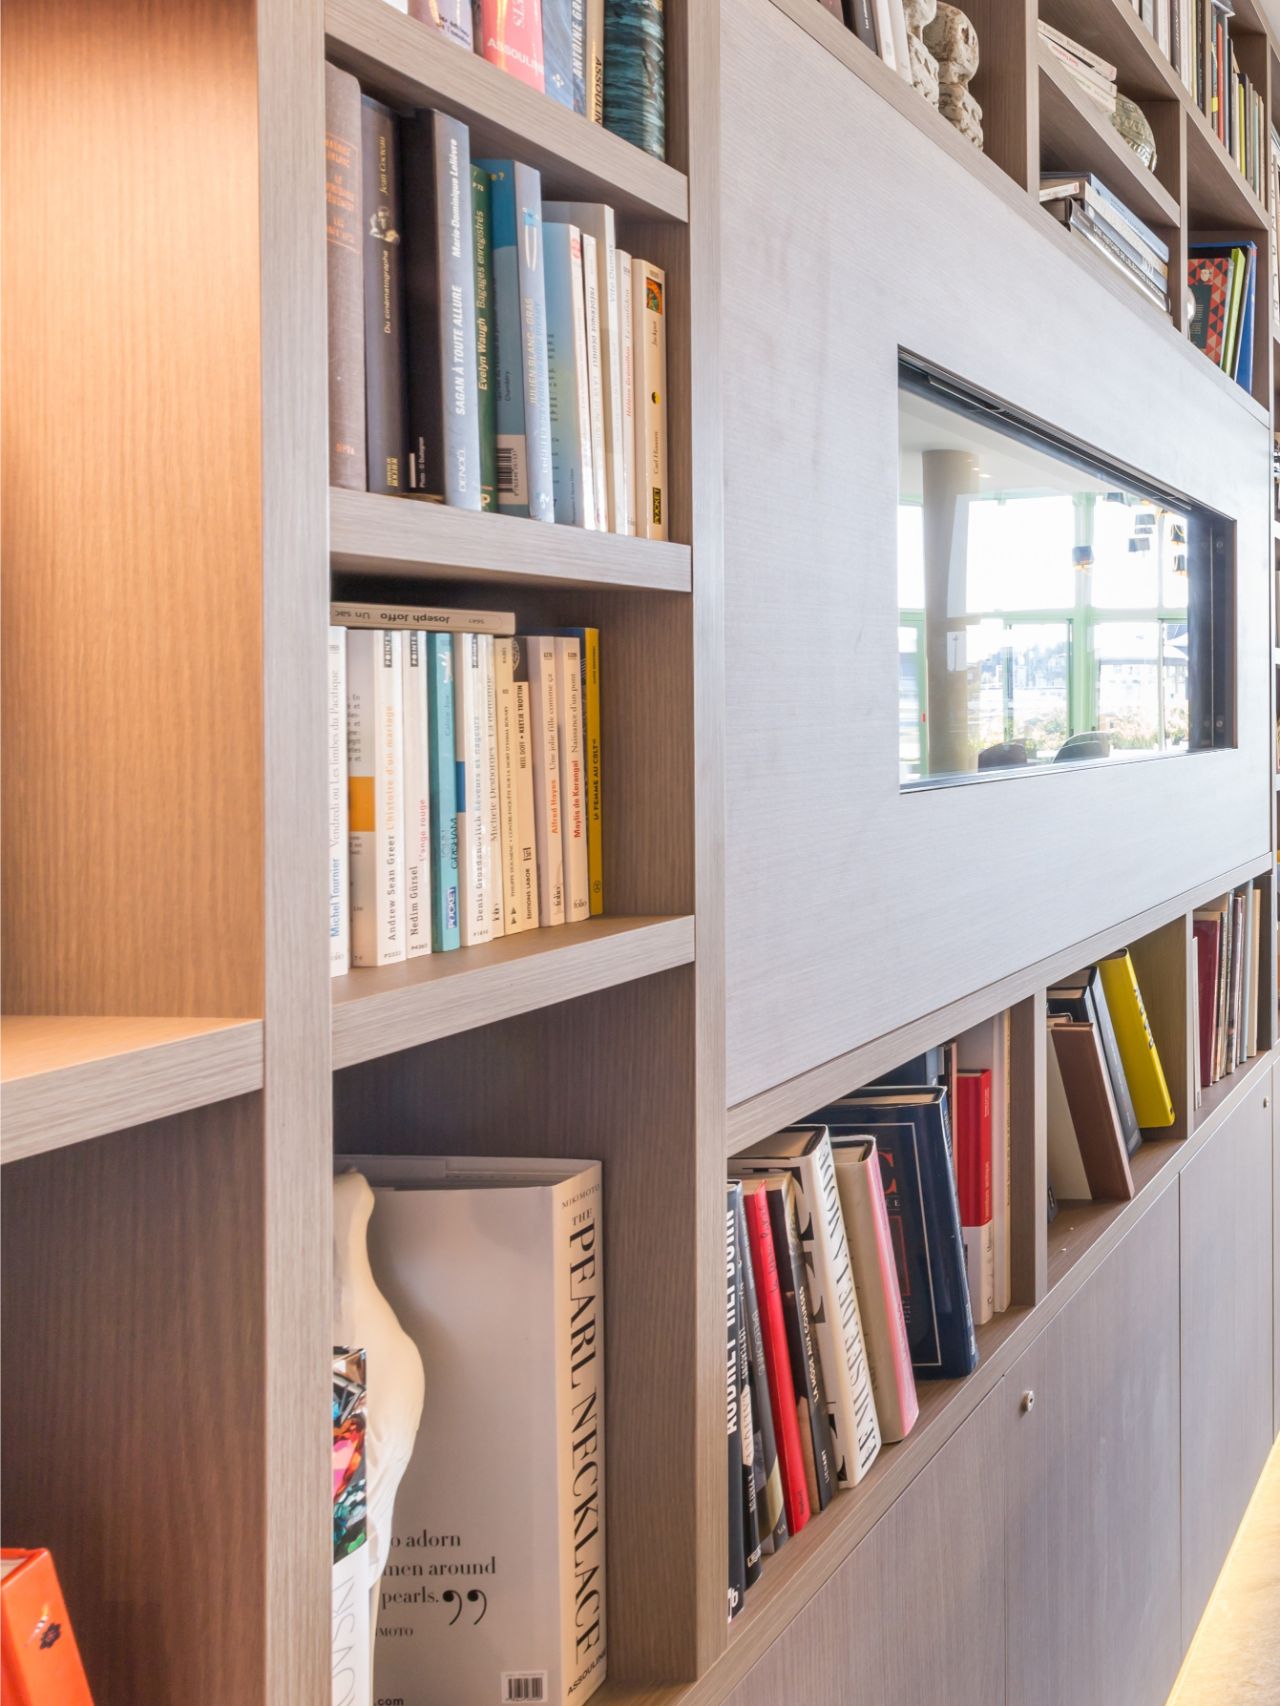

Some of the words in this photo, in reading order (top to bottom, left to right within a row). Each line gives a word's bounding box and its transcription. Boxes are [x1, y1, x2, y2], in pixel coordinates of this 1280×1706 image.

[572, 21, 584, 79] ANTOINE
[474, 210, 486, 265] enregistrés
[382, 249, 392, 318] cinématographe
[475, 265, 487, 309] Bagages
[451, 285, 463, 328] ALLURE
[454, 330, 464, 364] TOUTE
[476, 318, 489, 354] Waugh
[453, 366, 465, 375] À
[479, 355, 490, 391] Evelyn
[456, 376, 466, 416] SAGAN
[652, 487, 661, 524] POCKET
[335, 609, 352, 618] sac
[355, 611, 371, 620] Un
[380, 611, 409, 623] Joffo
[413, 612, 450, 624] Joseph
[329, 669, 342, 715] Pacifique
[517, 685, 525, 711] TROTTIN
[547, 681, 555, 715] comme
[329, 717, 340, 731] du
[385, 704, 395, 748] mariage
[329, 733, 340, 766] limbes
[330, 768, 340, 785] Les
[332, 787, 340, 800] ou
[329, 802, 340, 848] Vendredi
[418, 798, 427, 827] rouge
[573, 810, 582, 838] Maylis
[386, 834, 396, 865] Greer
[329, 858, 340, 899] Tournier
[386, 869, 396, 895] Sean
[409, 865, 418, 899] Gürsel
[329, 900, 340, 938] Michel
[387, 899, 397, 941] Andrew
[410, 900, 419, 936] Nedim
[476, 892, 485, 922] Denis
[562, 1184, 600, 1209] MIKIMOTO
[818, 1141, 841, 1239] MODE
[572, 1208, 593, 1226] THE
[569, 1217, 598, 1391] PEARL
[799, 1286, 811, 1331] COURSES
[836, 1281, 859, 1339] DE
[803, 1334, 813, 1358] AUX
[807, 1359, 818, 1391] MODE
[813, 1390, 820, 1405] LA
[858, 1416, 879, 1470] LE
[390, 1535, 402, 1548] o
[406, 1529, 462, 1549] adorn
[571, 1387, 602, 1666] NECKLACE
[381, 1564, 424, 1577] men
[428, 1556, 497, 1577] around
